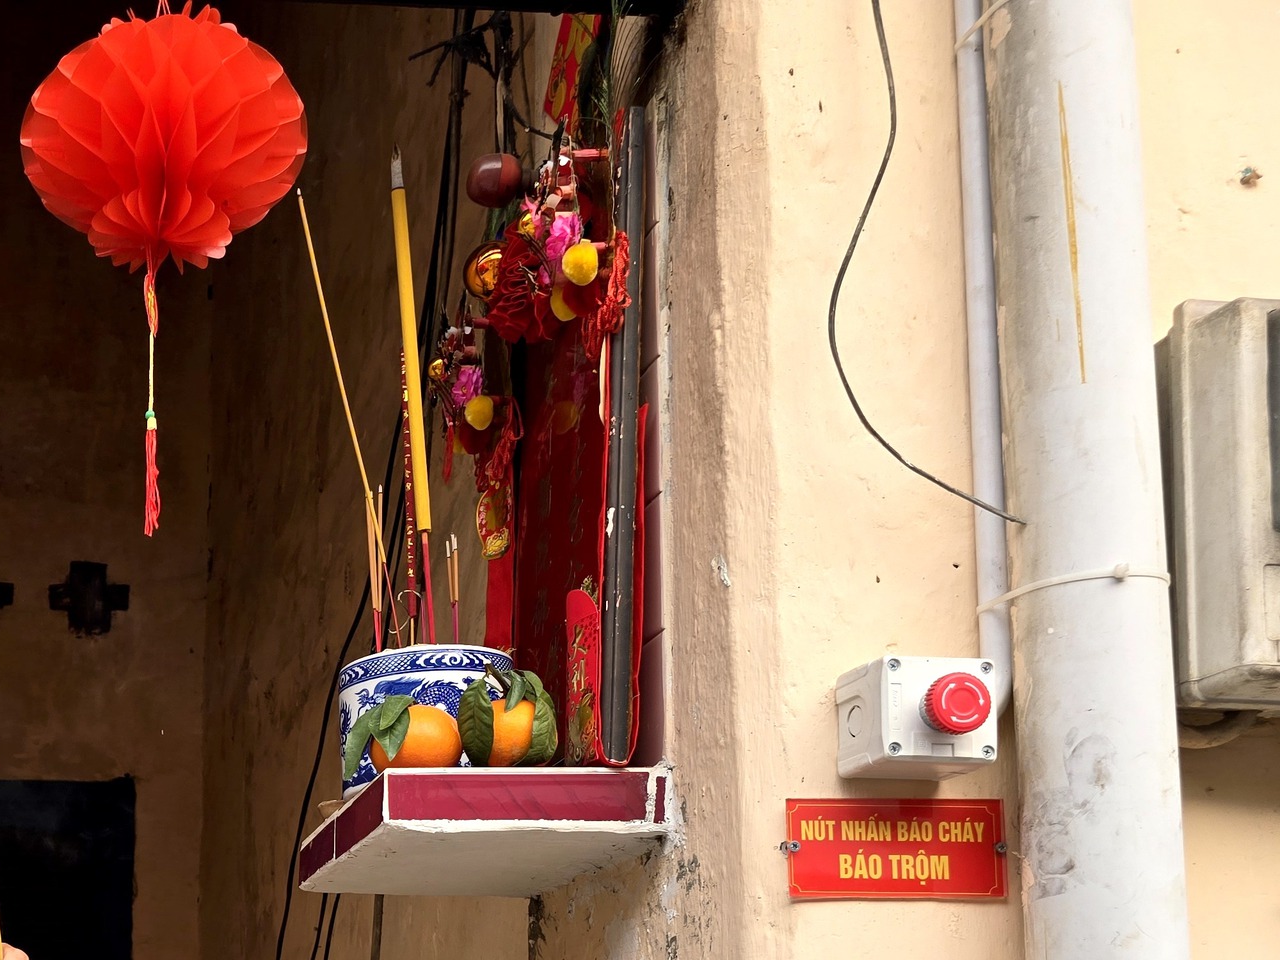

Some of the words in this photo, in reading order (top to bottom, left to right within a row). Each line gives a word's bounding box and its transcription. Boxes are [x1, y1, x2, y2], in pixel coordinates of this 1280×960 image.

[800, 816, 836, 841] NÚT
[841, 814, 892, 842] NHẤN
[897, 817, 933, 842] BÁO
[938, 818, 985, 843] CHÁY
[839, 849, 882, 880] BÁO
[888, 850, 950, 886] TRỘM
